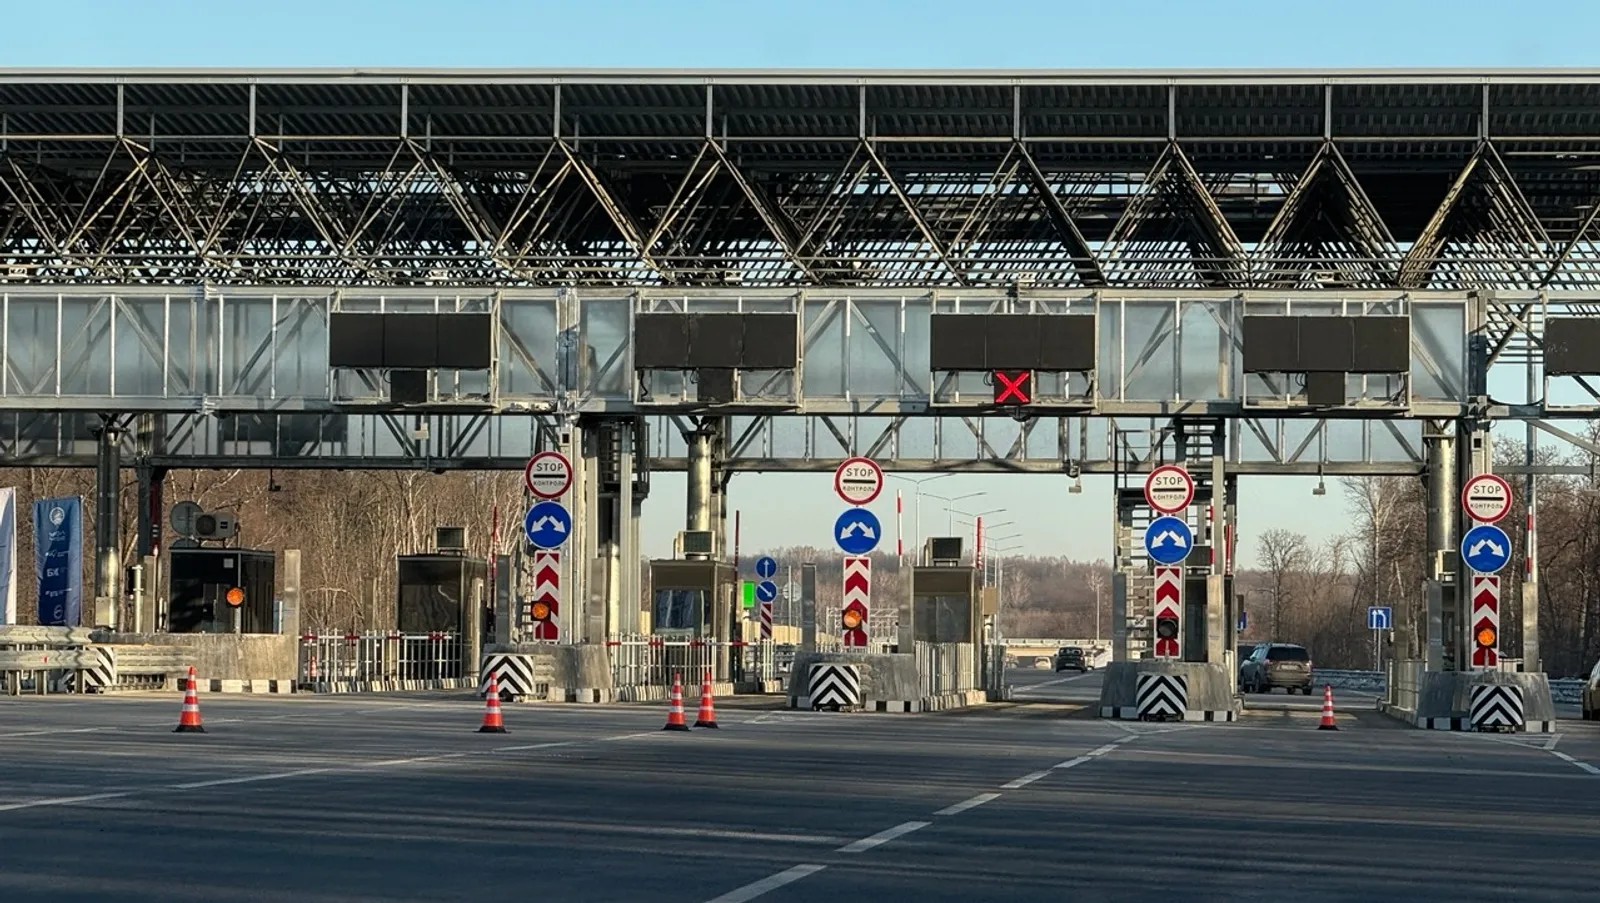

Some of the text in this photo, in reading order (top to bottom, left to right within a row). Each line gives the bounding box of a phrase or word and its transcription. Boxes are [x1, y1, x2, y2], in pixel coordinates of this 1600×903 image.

[536, 462, 564, 472] STOP
[846, 467, 874, 477] STOP
[1155, 476, 1184, 486] STOP
[1473, 485, 1502, 494] STOP
